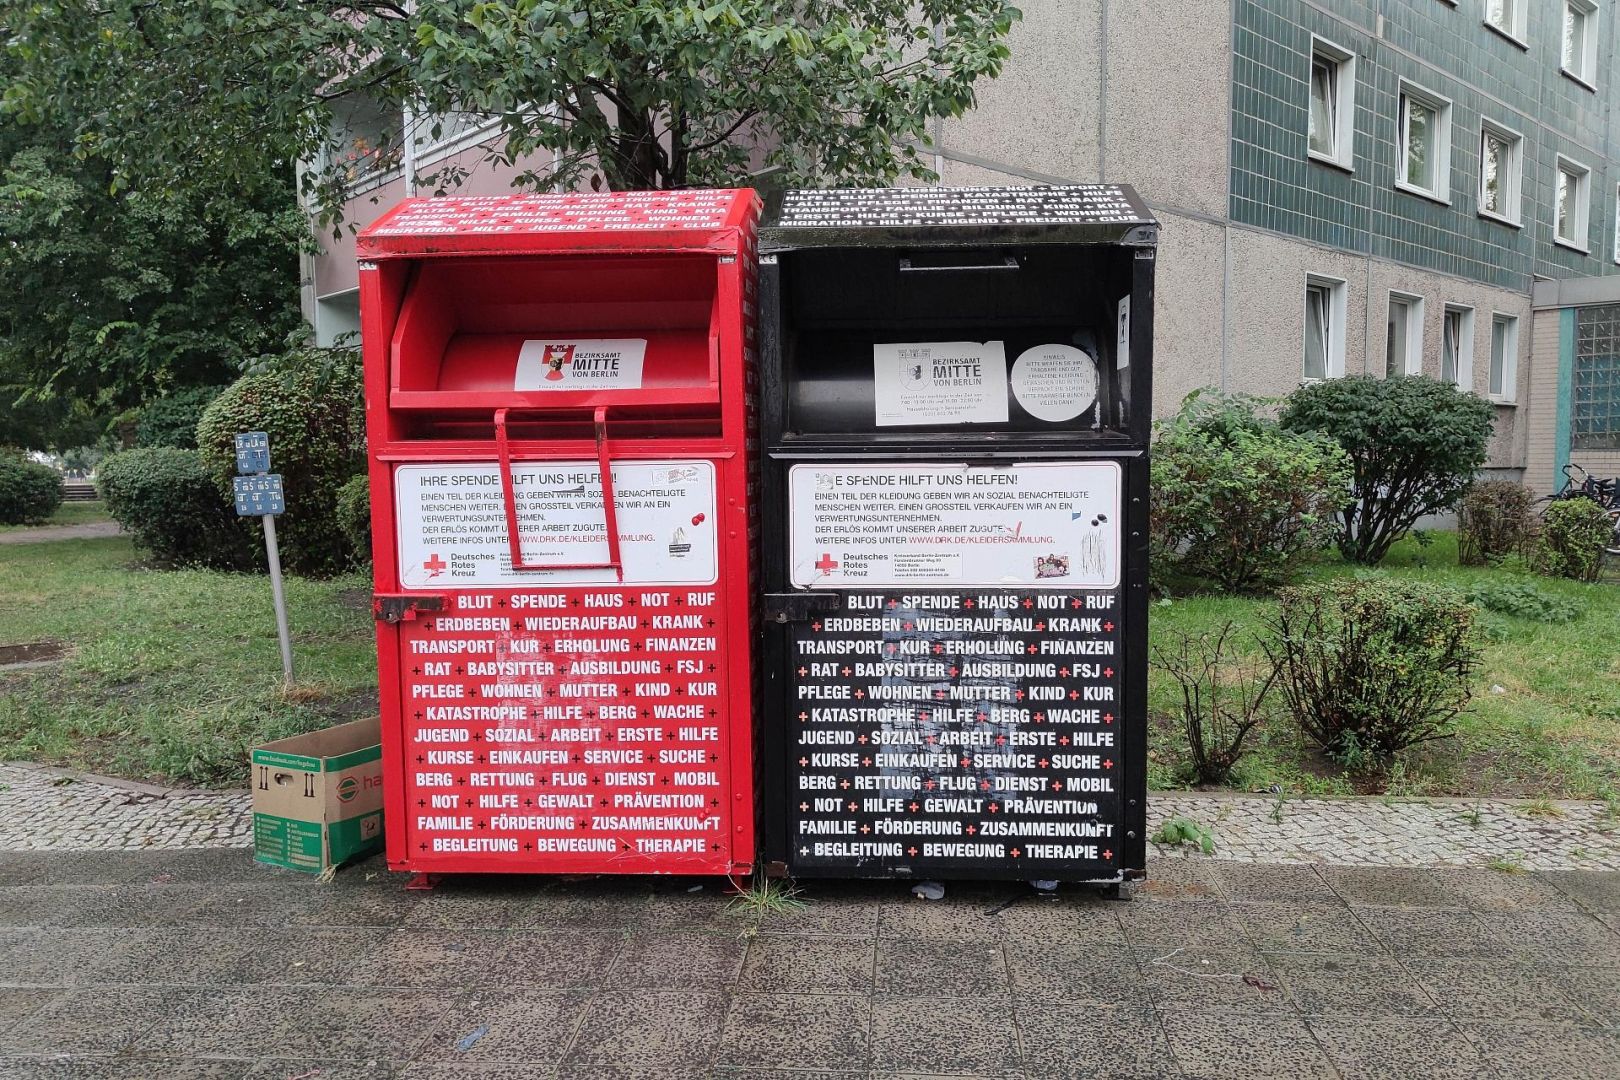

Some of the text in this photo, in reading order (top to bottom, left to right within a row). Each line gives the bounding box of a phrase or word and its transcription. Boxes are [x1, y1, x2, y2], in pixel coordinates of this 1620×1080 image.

[572, 359, 620, 370] MITTE
[933, 365, 982, 378] MITTE
[953, 378, 982, 386] BERLIN
[420, 476, 448, 486] IHRE
[451, 475, 499, 486] SPENDE
[539, 474, 564, 484] UNS
[846, 475, 896, 485] SPENDE
[899, 475, 933, 485] HILFT
[936, 475, 963, 485] UNS
[967, 474, 1018, 485] HELFEN!
[814, 491, 1089, 500] EINEN TEIL DER KLEIDUNG GEBEN WIR AN SOZIAL BENACHTEILIGTE
[814, 502, 1073, 511] MENSCHEN WEITER. EINEN GROSSTEIL VERKAUFEN WIR AN EIN
[814, 514, 942, 522] VERWERTUNGSUNTERNEHMEN.
[834, 524, 860, 533] ERLÖS
[862, 525, 893, 533] KOMMT
[896, 525, 936, 533] UNSERER
[937, 525, 967, 533] ARBEIT
[969, 525, 1006, 533] ZUGUTE.
[815, 536, 850, 544] WEITERE
[852, 536, 877, 544] INFOS
[879, 536, 907, 544] UNTER
[451, 553, 496, 561] Deutsches
[843, 553, 889, 561] Deutsches
[843, 569, 868, 577] Kreuz
[458, 592, 715, 609] BLUT SPENDE HAUS NOT RUF
[847, 595, 1115, 609] BLUT SPENDE HAUS NOT RUF
[824, 618, 1102, 632] ERDBEBEN WIEDERAUFBAU KRANK
[410, 637, 716, 654] TRANSPORT KUR ERHOLUNG FINANZEN
[797, 641, 1114, 655] TRANSPORT KUR ERHOLUNG FINANZEN
[811, 663, 1101, 677] RAT BABYSITTER AUSBILDUNG FSJ
[412, 682, 717, 698] PFLEGE WOHNEN MUTTER KIND KUR
[798, 686, 1114, 701] PFLEGE WOHNEN MUTTER KIND KUR
[812, 708, 1100, 723] KATASTROPHE HILFE BERG WACHE
[414, 727, 719, 743] JUGEND SOZIAL ARBEIT ERSTE HILFE
[798, 730, 1114, 747] JUGEND SOZIAL ARBEIT ERSTE HILFE
[812, 753, 1101, 769] KURSE EINKAUFEN SERVICE SUCHE
[416, 772, 720, 787] BERG RETTUNG FLUG DIENST MOBIL
[799, 776, 1114, 792] BERG RETTUNG FLUG DIENST MOBIL
[814, 797, 1098, 815] NOT HILFE GEWALT PRÄVENTION
[417, 814, 720, 830] FAMILIE FÖRDERUNG ZUSAMMENKUNFT
[799, 818, 1113, 837] FAMILIE FÖRDERUNG ZUSAMMENKUNFT
[814, 843, 1098, 859] BEGLEITUNG BEWEGUNG THERAPIE
